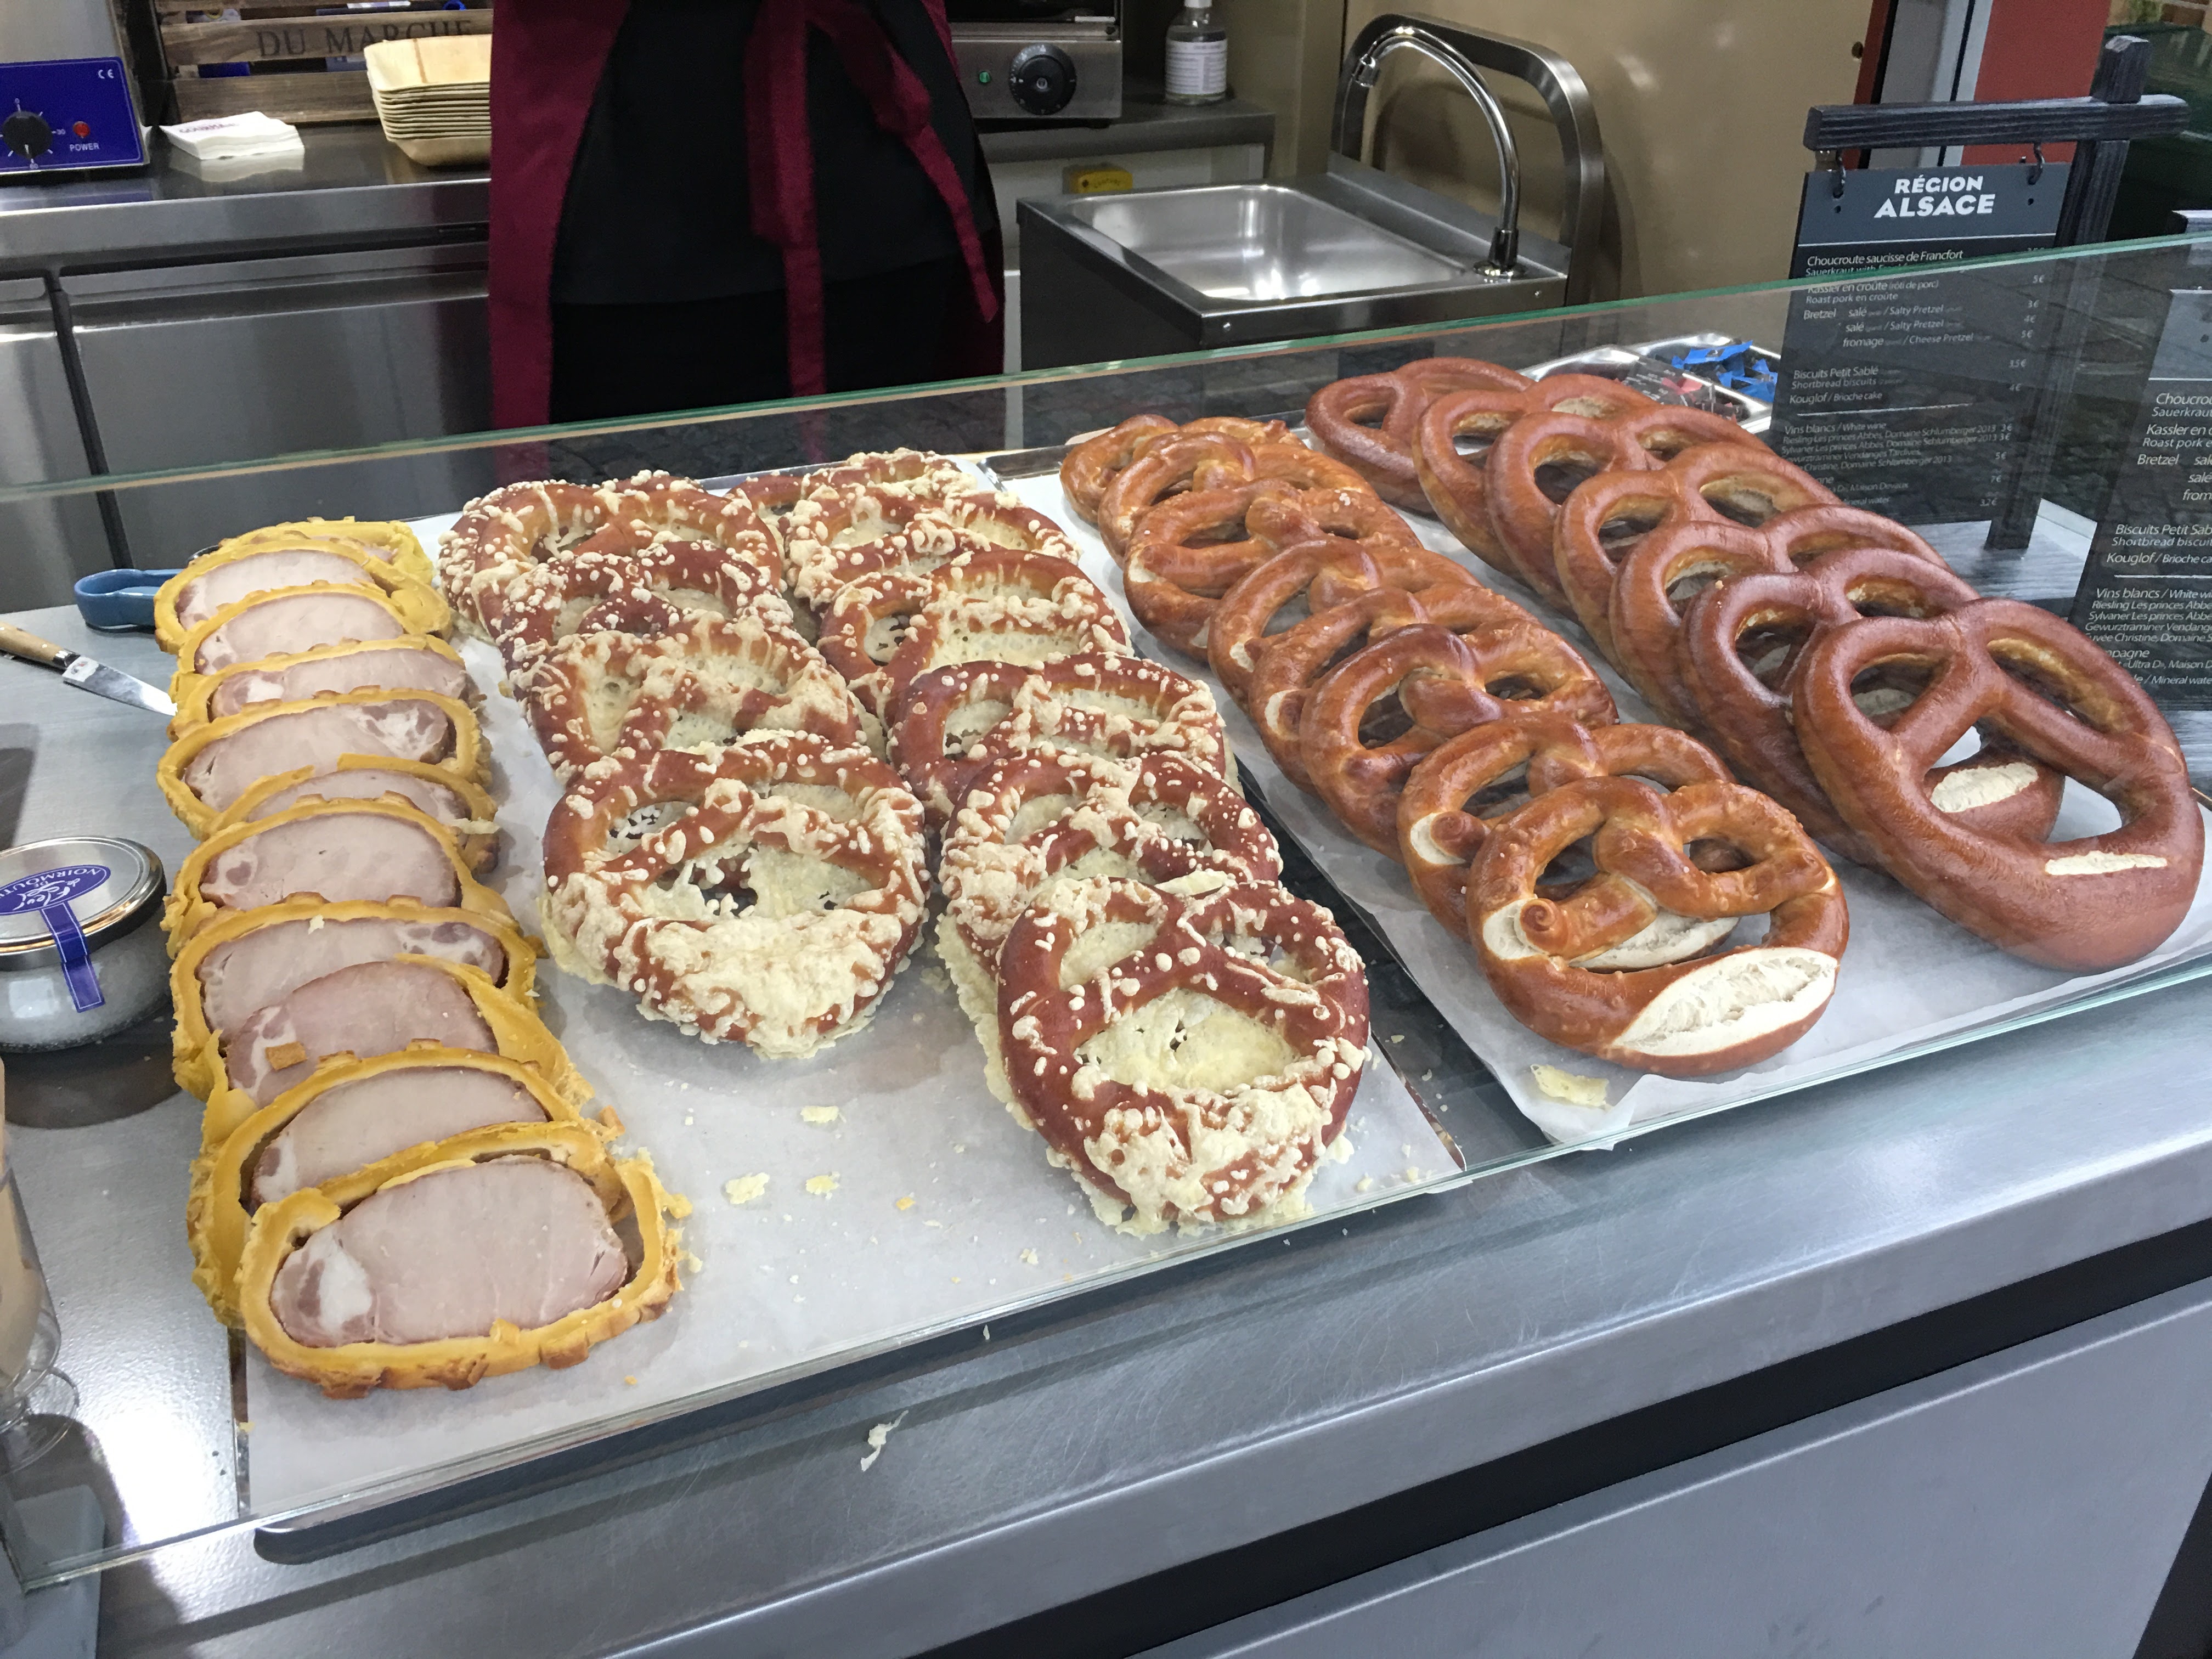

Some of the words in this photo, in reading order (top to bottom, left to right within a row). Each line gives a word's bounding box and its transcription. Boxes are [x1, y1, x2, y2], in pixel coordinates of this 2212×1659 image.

[256, 28, 306, 57] DU
[69, 143, 99, 151] POWER
[1894, 174, 1983, 194] RÉGION
[1874, 194, 1995, 218] ALSACE
[1807, 255, 1865, 266] Choucroute
[1866, 253, 1905, 263] saucisse
[1906, 251, 1920, 262] de
[1920, 250, 1963, 261] Francfort
[1805, 295, 1830, 304] Roast
[1832, 294, 1853, 304] pork
[1804, 308, 1837, 320] Bretzel
[1848, 307, 1867, 317] salé
[1890, 306, 1911, 315] Salty
[1912, 304, 1944, 314] Pretzel
[1846, 321, 1864, 332] salé
[1891, 321, 1912, 331] Salty
[1914, 319, 1944, 329] Pretzel
[1843, 337, 1884, 348] fromage
[1909, 335, 1942, 344] Cheese
[1943, 332, 1974, 341] Pretzel
[1793, 369, 1828, 379] Biscuits
[1830, 368, 1851, 377] Petit
[1853, 365, 1878, 376] Sablé
[1791, 379, 1841, 390] Shortbread
[1843, 377, 1876, 386] biscuits
[1790, 392, 1827, 405] Kouglof
[1833, 392, 1863, 402] Brioche
[1864, 391, 1882, 399] cake
[1785, 426, 1804, 435] Vins
[1806, 424, 1835, 433] blancs
[2146, 424, 2190, 435] Kassler
[2190, 426, 2206, 435] en
[2142, 437, 2174, 447] Roast
[2176, 438, 2203, 449] pork
[2137, 454, 2180, 465] Bretzel
[2115, 524, 2159, 534] Biscuits
[2161, 524, 2190, 535] Petit
[2112, 537, 2175, 546] Shortbread
[2106, 552, 2156, 566] Kouglof
[2162, 554, 2200, 563] Brioche
[2097, 588, 2120, 598] Vins
[2123, 588, 2160, 599] blancs
[2169, 589, 2198, 598] White
[2092, 601, 2129, 611] Riesling
[2131, 601, 2149, 610] Les
[2148, 601, 2184, 611] princes
[2089, 611, 2130, 622] Sylvaner
[2131, 612, 2147, 620] Les
[2148, 612, 2184, 622] princes
[2085, 622, 2165, 631] Gewurztraminer
[2086, 633, 2113, 642] uvée
[2160, 633, 2206, 642] Domaine
[2168, 660, 2204, 668] Maison
[2151, 676, 2188, 685] Mineral
